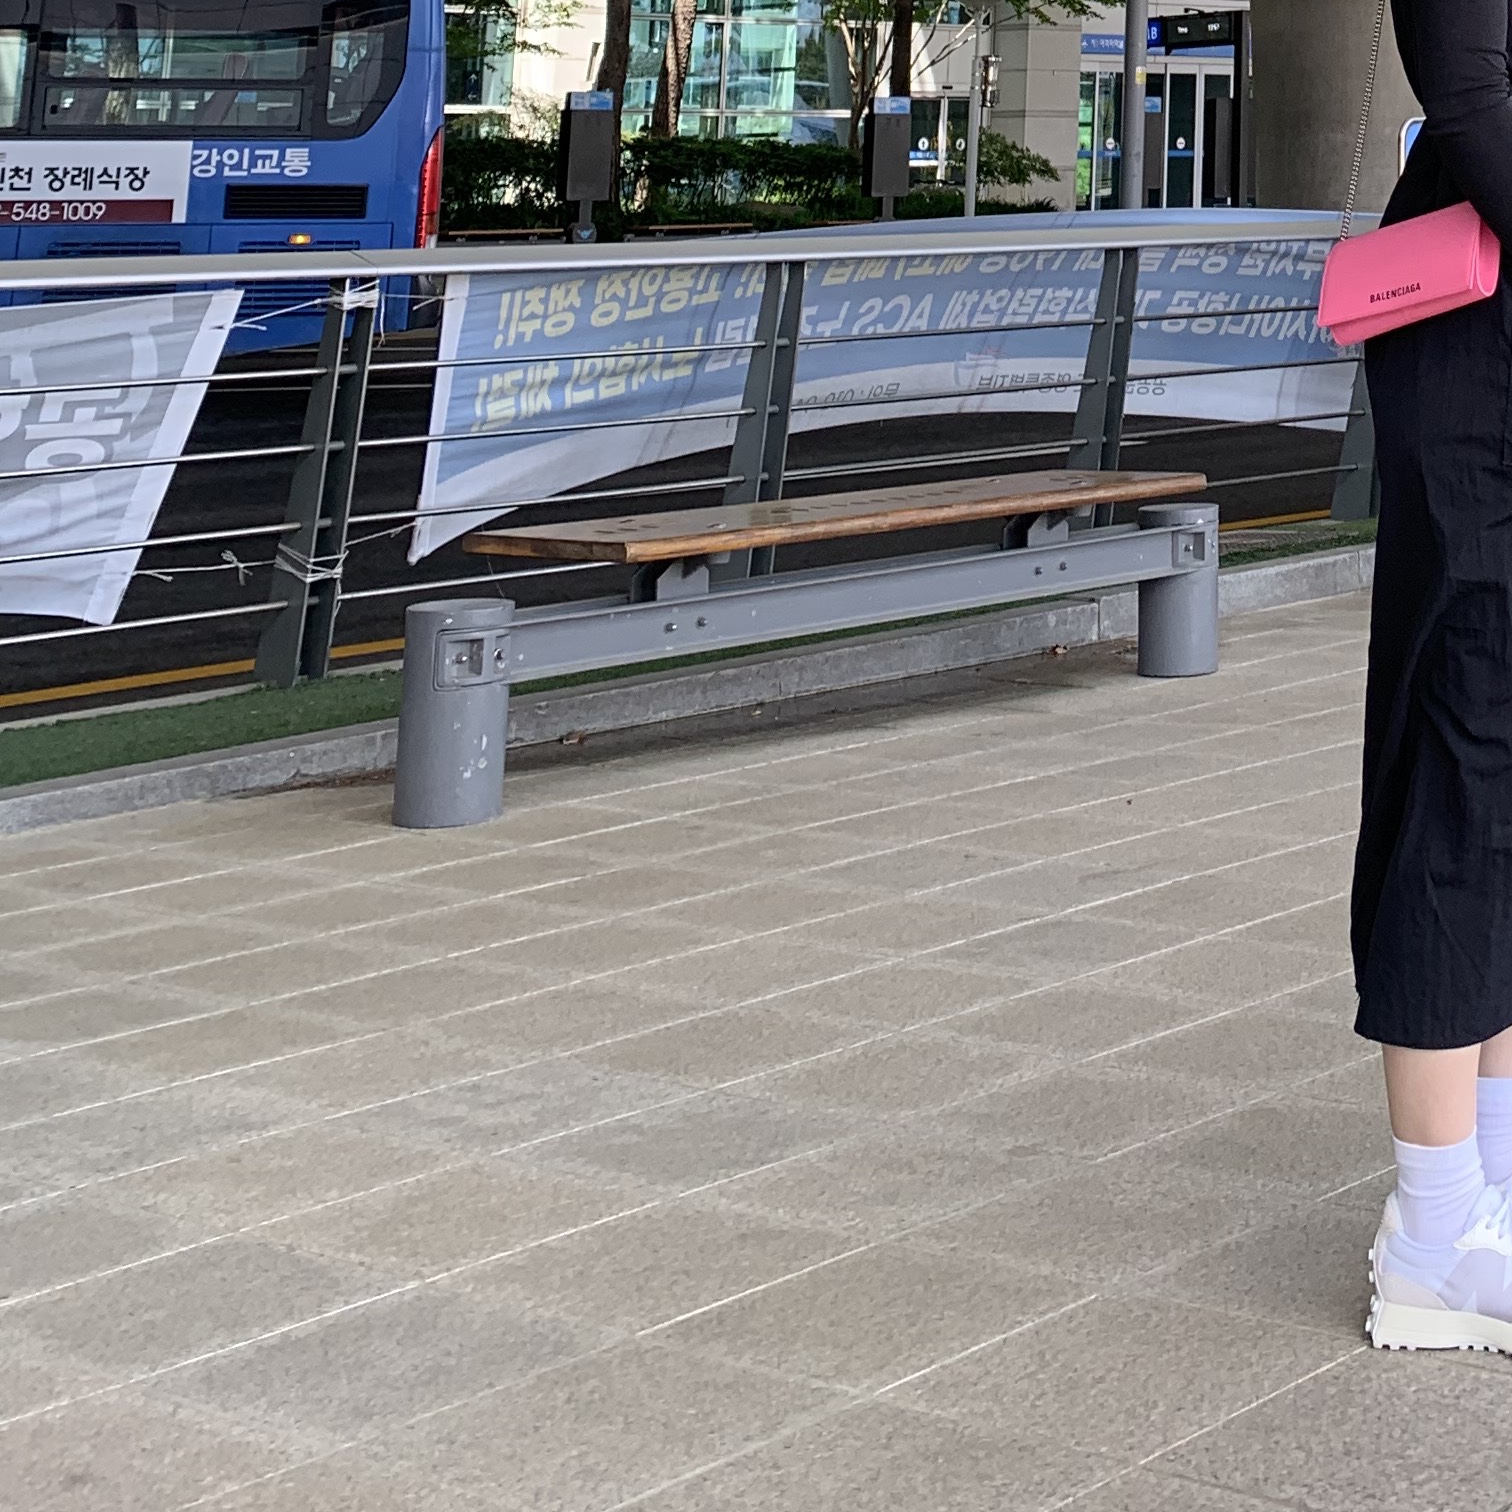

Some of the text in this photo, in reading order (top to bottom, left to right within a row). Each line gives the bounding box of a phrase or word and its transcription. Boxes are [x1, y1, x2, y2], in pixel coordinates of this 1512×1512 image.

[191, 147, 312, 178] 강인교통
[43, 166, 151, 193] 장례식장
[0, 202, 107, 221] -548-1009
[1369, 282, 1421, 304] BALENCIAGA
